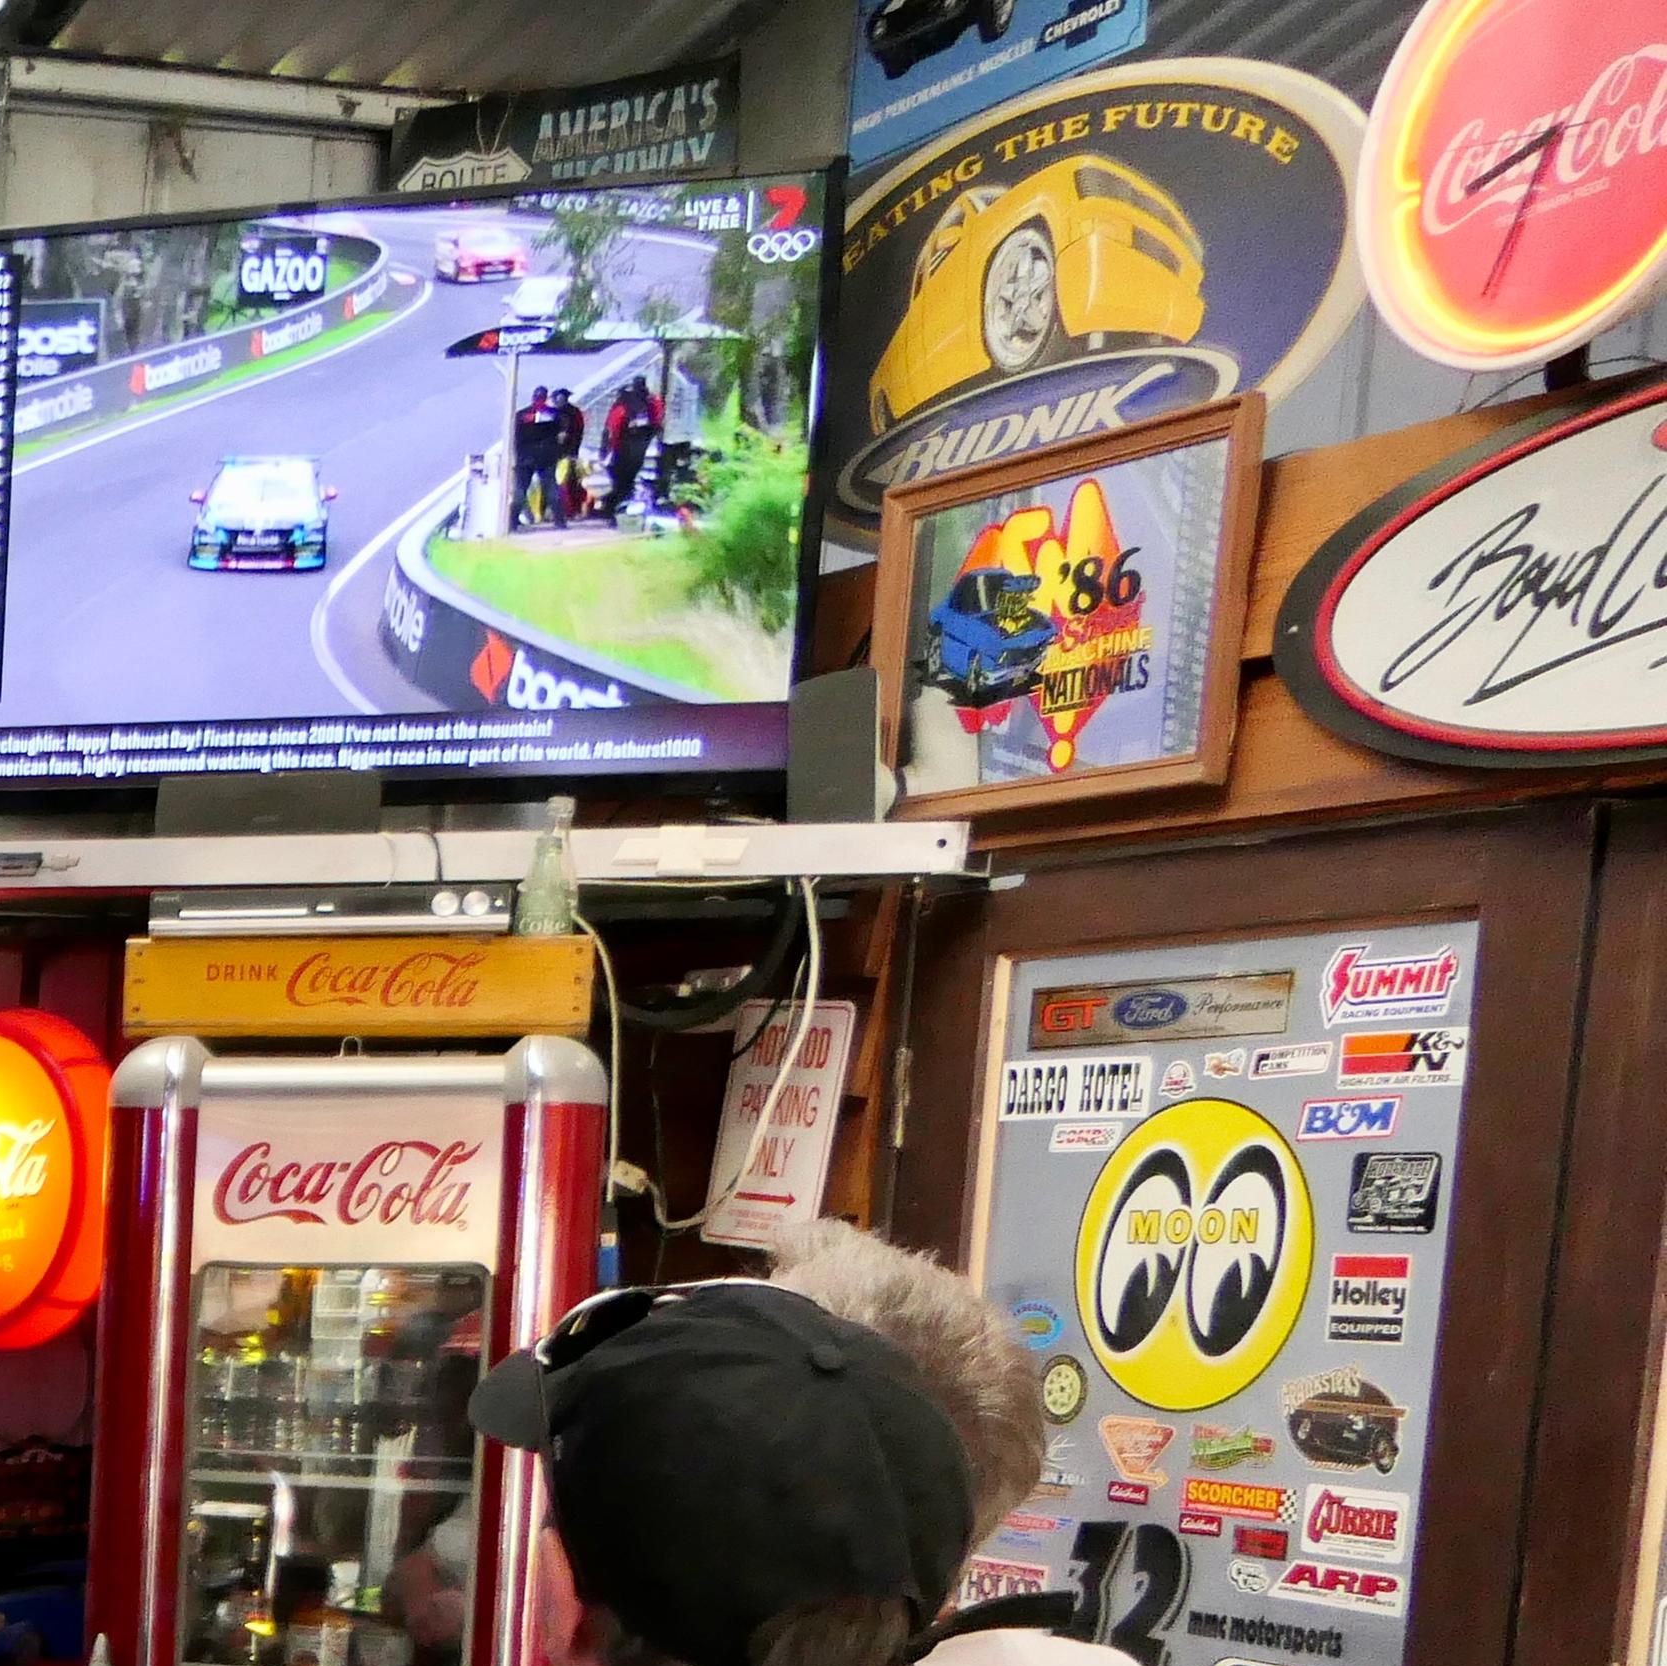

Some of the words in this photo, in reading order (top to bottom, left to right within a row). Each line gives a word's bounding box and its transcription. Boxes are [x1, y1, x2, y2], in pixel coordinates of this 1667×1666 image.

[534, 78, 720, 162] AMERICA'S
[685, 201, 723, 217] LIVE
[725, 198, 741, 214] &
[842, 152, 984, 274] EATING
[999, 112, 1091, 165] THE
[1102, 100, 1299, 166] FUTURE
[698, 213, 740, 232] FREE
[241, 255, 325, 293] GAZOO
[890, 362, 1175, 488] BUDNIK
[1060, 547, 1142, 616] '86
[1043, 654, 1151, 707] NATIONALS
[68, 733, 110, 755] Happy
[110, 728, 170, 749] Bathurst
[236, 729, 268, 747] race
[269, 727, 307, 746] since
[373, 722, 397, 741] not
[399, 721, 434, 741] been
[435, 720, 452, 740] at
[453, 720, 478, 739] the
[479, 718, 553, 738] mountain!
[49, 755, 83, 776] fans,
[83, 753, 125, 778] highly
[126, 752, 206, 773] recommend
[207, 751, 272, 773] watching
[272, 749, 300, 769] this
[301, 751, 336, 768] race.
[337, 748, 394, 771] Biggest
[394, 749, 426, 767] race
[427, 746, 442, 765] in
[443, 748, 468, 765] our
[469, 746, 500, 768] part
[501, 744, 518, 763] of
[519, 743, 544, 762] the
[546, 742, 592, 761] world.
[593, 738, 701, 761] #Bathurst1000
[206, 961, 279, 984] DRINK
[284, 950, 489, 1009] Coca-Cola
[1329, 952, 1458, 1009] SUMMIT
[1041, 998, 1109, 1033] GT
[1125, 998, 1174, 1028] Ford
[1190, 991, 1284, 1023] Performance
[1341, 1009, 1379, 1020] RACING
[1383, 1004, 1446, 1017] EQUIPMENT
[1005, 1065, 1068, 1116] DARGO
[1080, 1061, 1145, 1111] HOTEL
[1304, 1100, 1396, 1135] B&M
[210, 1138, 483, 1230] Coca-Cola
[1127, 1208, 1260, 1245] MOON
[1332, 1280, 1405, 1314] Holley
[1331, 1321, 1403, 1337] EQUIPPED
[1188, 1482, 1279, 1511] SCORCHER
[1307, 1489, 1400, 1543] CURRIE
[1283, 1563, 1400, 1597] ARP
[1187, 1610, 1226, 1640] mmc
[1229, 1616, 1343, 1659] motorsports
